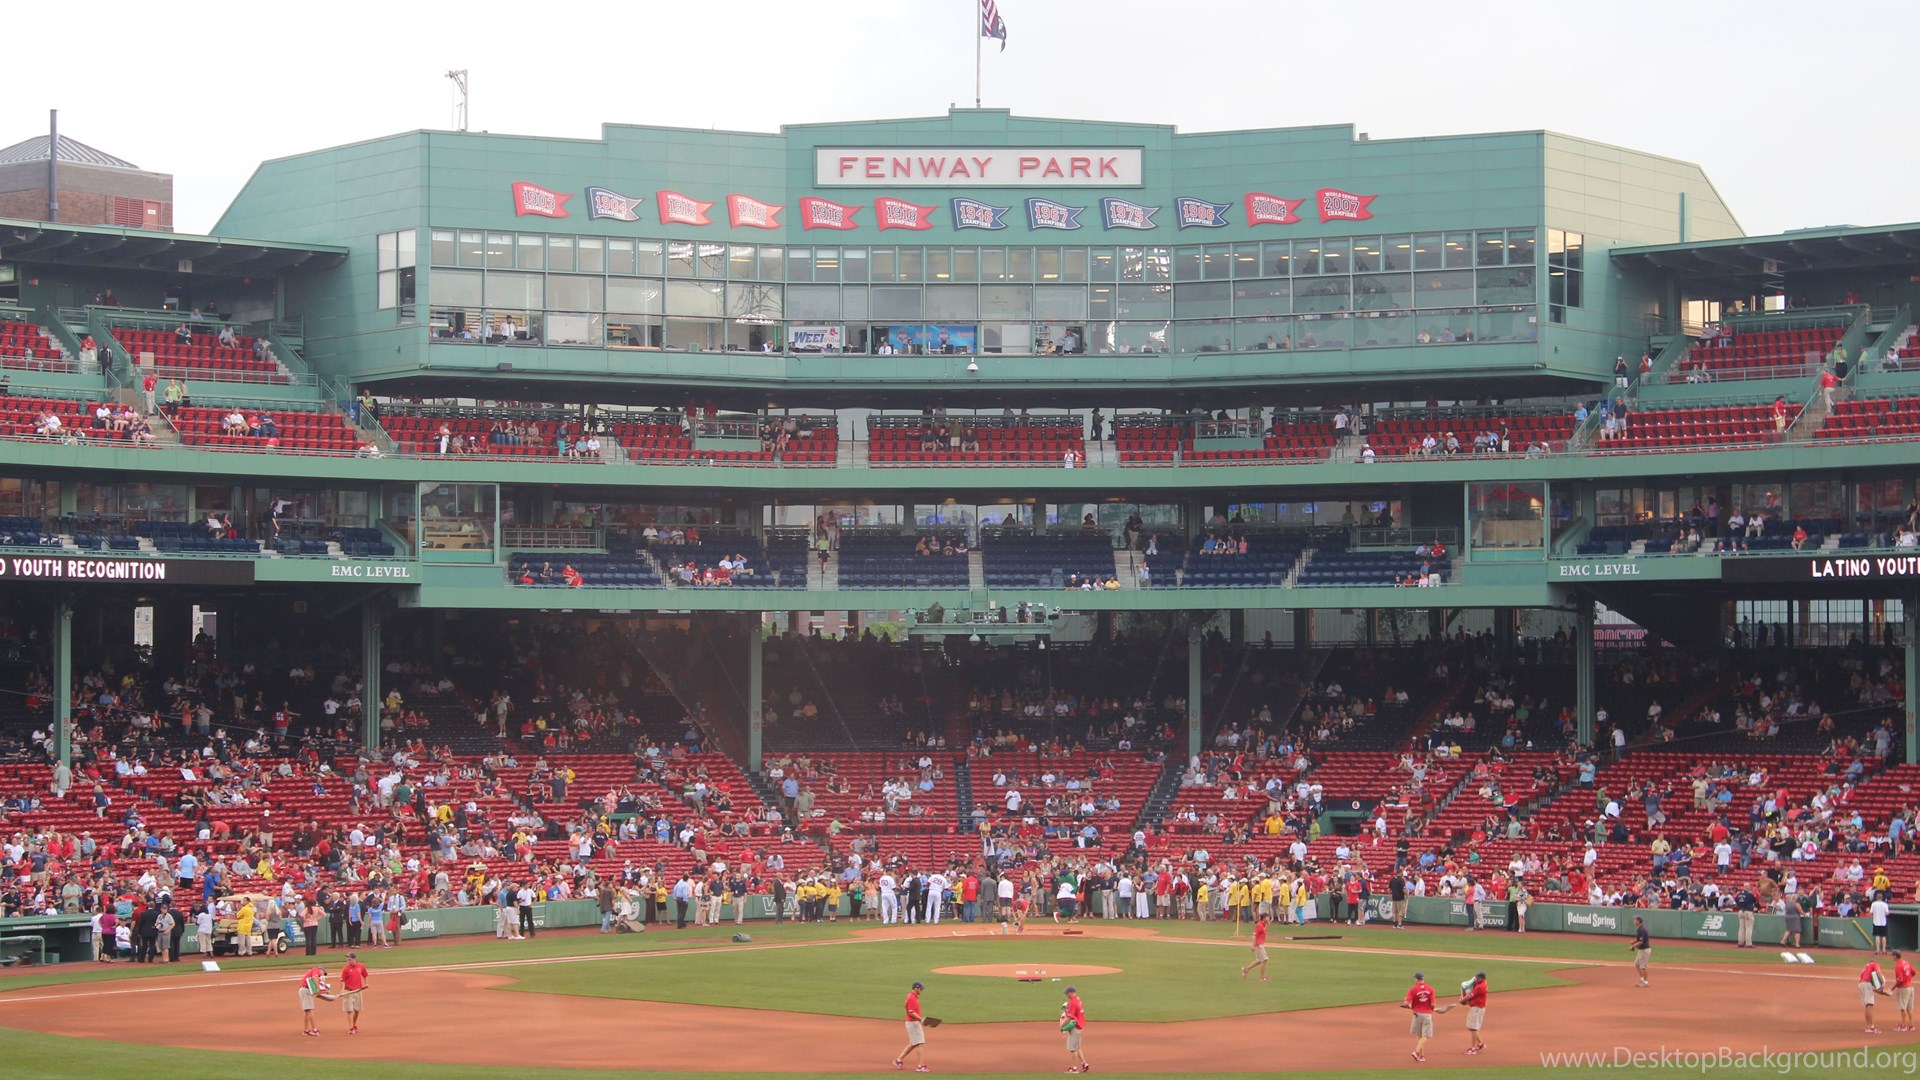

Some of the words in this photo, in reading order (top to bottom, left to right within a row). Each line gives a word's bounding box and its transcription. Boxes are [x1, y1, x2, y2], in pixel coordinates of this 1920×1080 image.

[839, 157, 993, 178] FENWAY
[1019, 157, 1120, 178] PARK
[523, 192, 555, 210] 1903
[525, 204, 552, 214] CHAMPIONS
[596, 196, 627, 214] 1904
[668, 200, 697, 217] 1912
[1253, 201, 1286, 217] 2004
[1324, 197, 1359, 214] 2007
[598, 209, 625, 219] CHAMPIONS
[669, 212, 696, 222] CHAMPIONS
[738, 203, 766, 220] 1915
[812, 206, 842, 222] 1916
[887, 206, 917, 222] 1918
[960, 206, 993, 223] 1946
[1035, 206, 1068, 223] 1967
[1111, 205, 1143, 223] 1975
[1183, 205, 1214, 220] 1986
[739, 216, 766, 225] CHAMPIONS
[813, 218, 841, 227] CHAMPIONS
[888, 218, 916, 227] CHAMPIONS
[962, 219, 990, 227] CHAMPIONS
[1038, 219, 1065, 227] CHAMPIONS
[1113, 219, 1140, 227] CHAMPIONS
[795, 332, 824, 343] WEEI
[13, 558, 62, 576] YOUTH
[68, 560, 165, 579] RECOGNITION
[332, 566, 361, 576] EMC
[366, 566, 409, 577] LEVEL
[1560, 565, 1590, 576] EMC
[1595, 564, 1640, 575] LEVEL
[1812, 559, 1870, 577] LATINO
[412, 918, 435, 932] Spring
[1568, 912, 1591, 925] Poland
[1592, 913, 1616, 929] Spring
